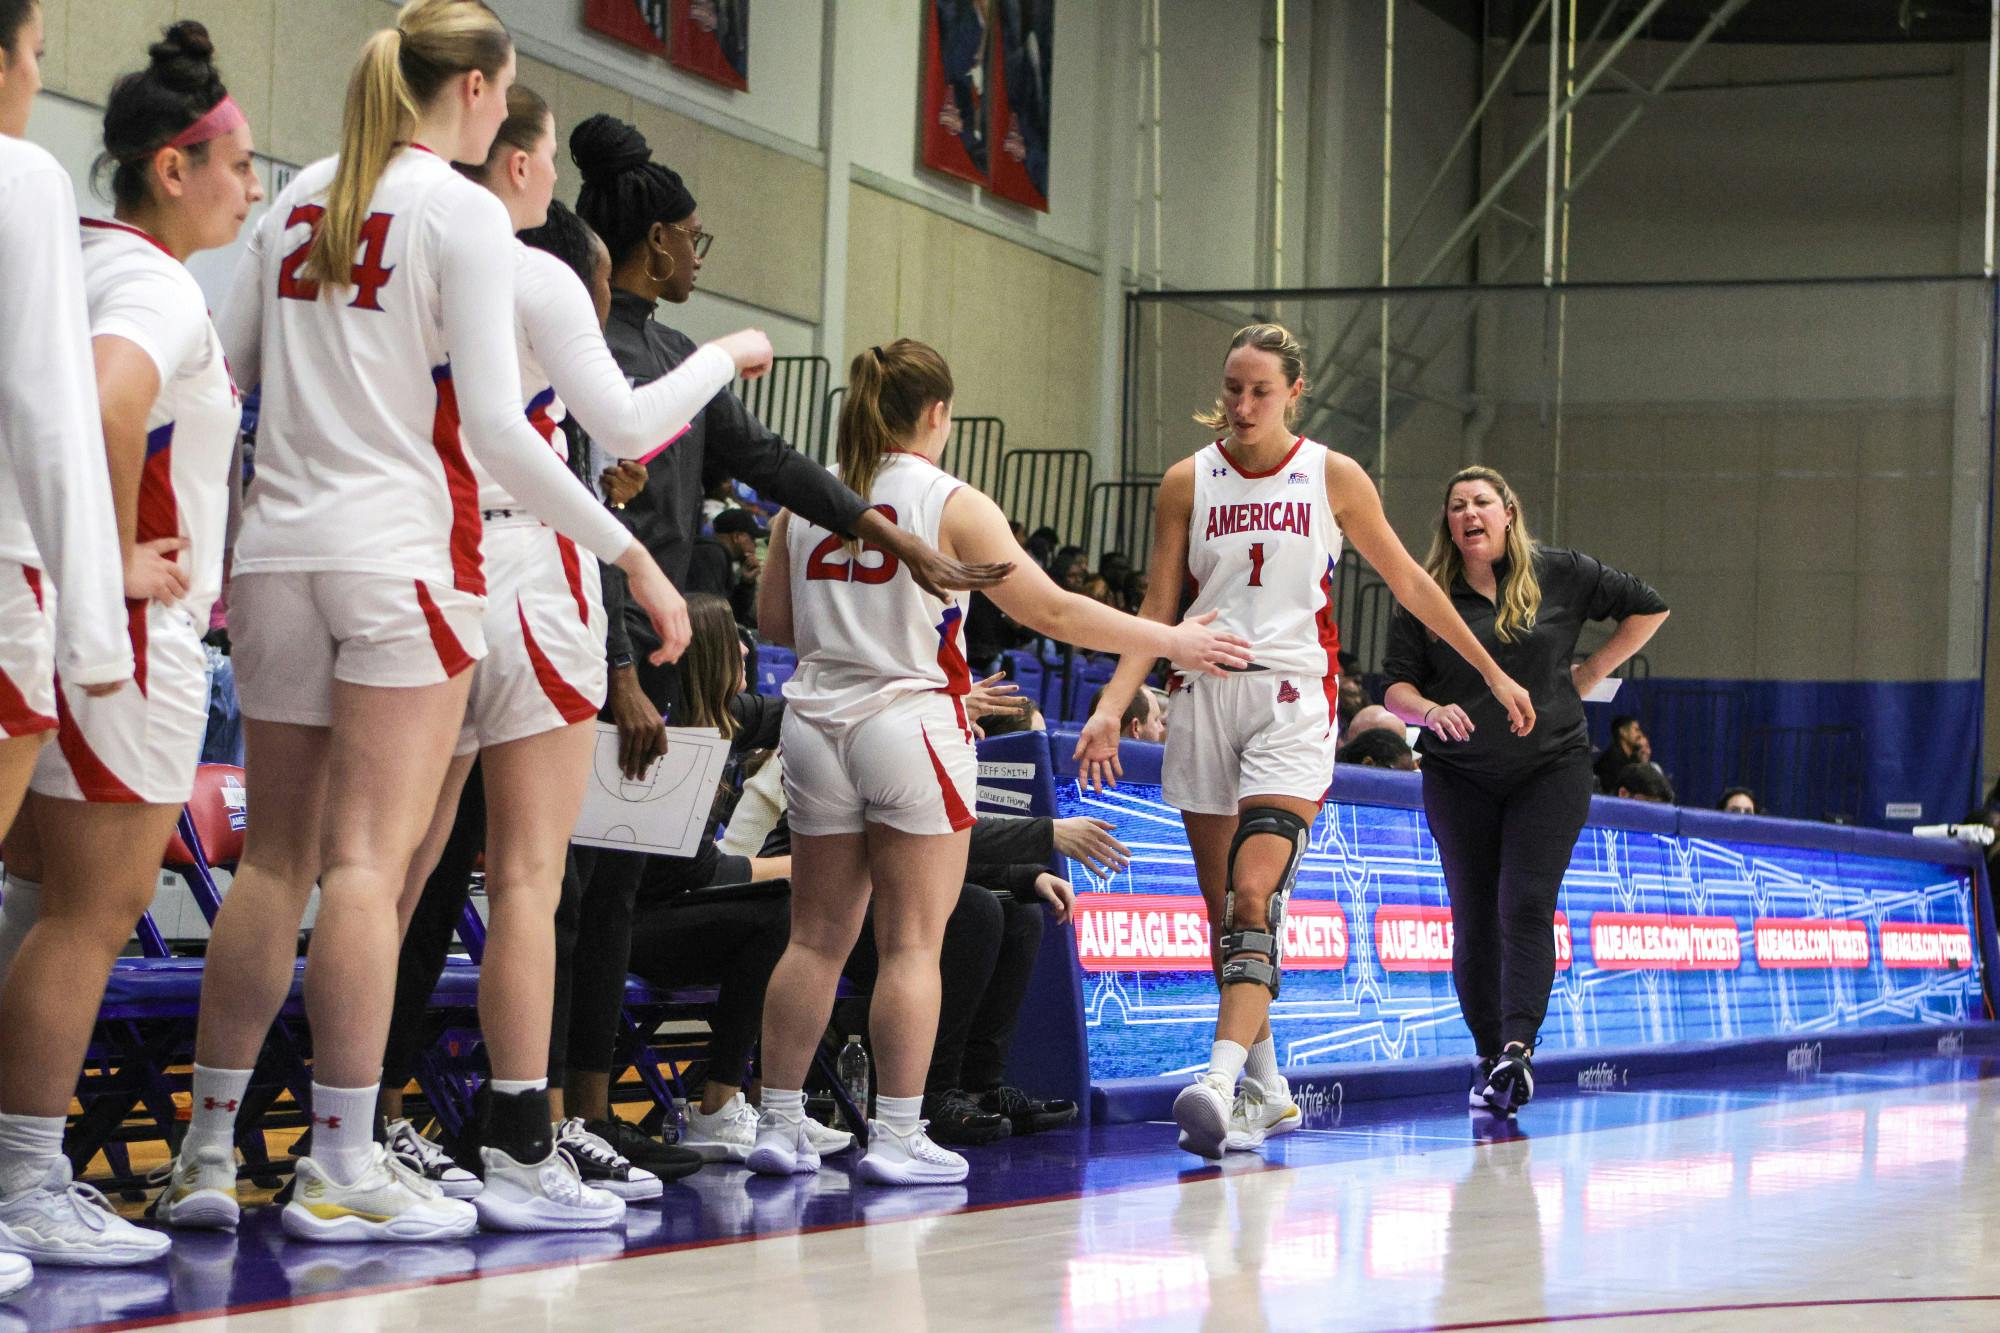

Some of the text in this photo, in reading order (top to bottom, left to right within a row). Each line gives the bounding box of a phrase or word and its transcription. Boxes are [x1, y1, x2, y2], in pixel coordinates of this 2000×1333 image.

[278, 203, 396, 312] 24
[1205, 502, 1311, 541] AMERICAN
[1247, 542, 1265, 586] 1
[978, 764, 1028, 777] JEFF SMITH
[232, 816, 247, 826] AME
[1080, 910, 1346, 958] AUEAGLES. CKETS
[1381, 920, 1454, 960] AUEAGLE
[1595, 924, 1740, 966] AUEAGLES.COM/TICKETS
[1757, 927, 1869, 964] AUEAGLES.COM/TICKETS
